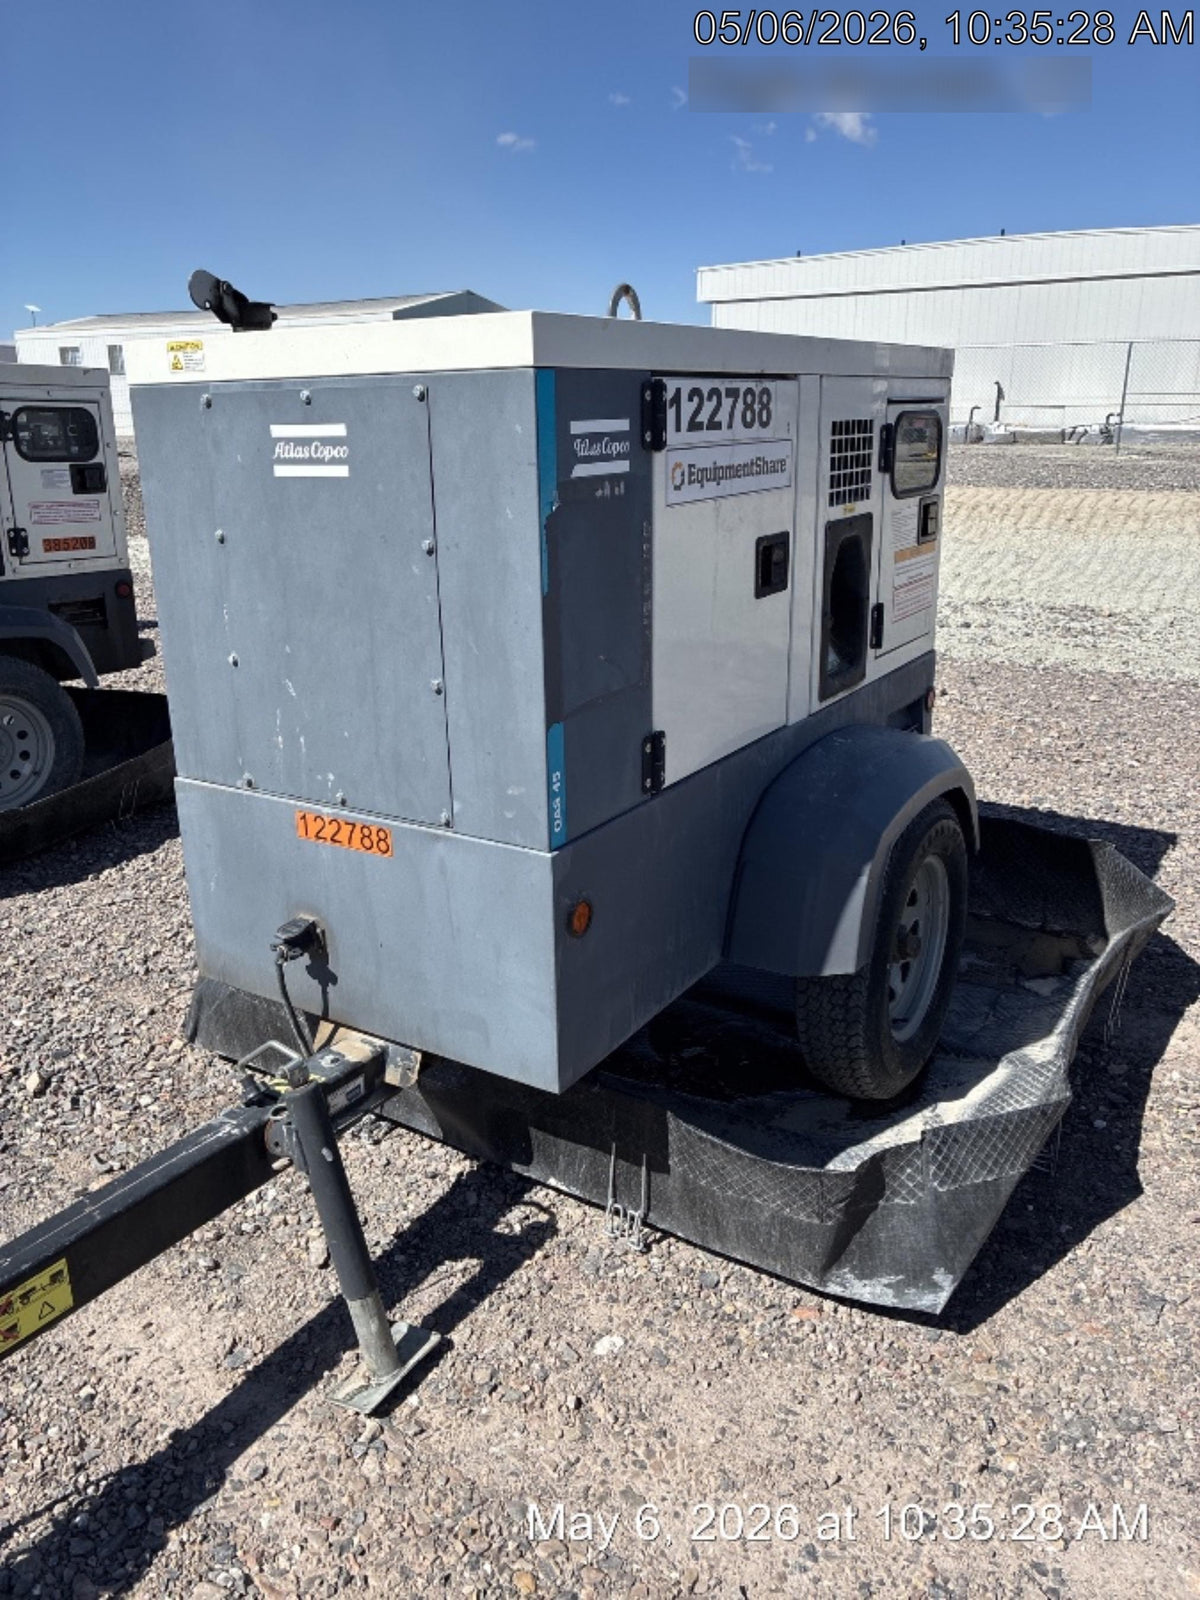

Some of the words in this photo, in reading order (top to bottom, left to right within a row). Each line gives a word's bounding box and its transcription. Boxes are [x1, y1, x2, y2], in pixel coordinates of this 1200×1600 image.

[668, 387, 772, 432] 122788
[272, 441, 310, 460] Atlas
[310, 441, 349, 462] Copco
[687, 456, 787, 488] EquipmentShare
[300, 812, 390, 854] 122788
